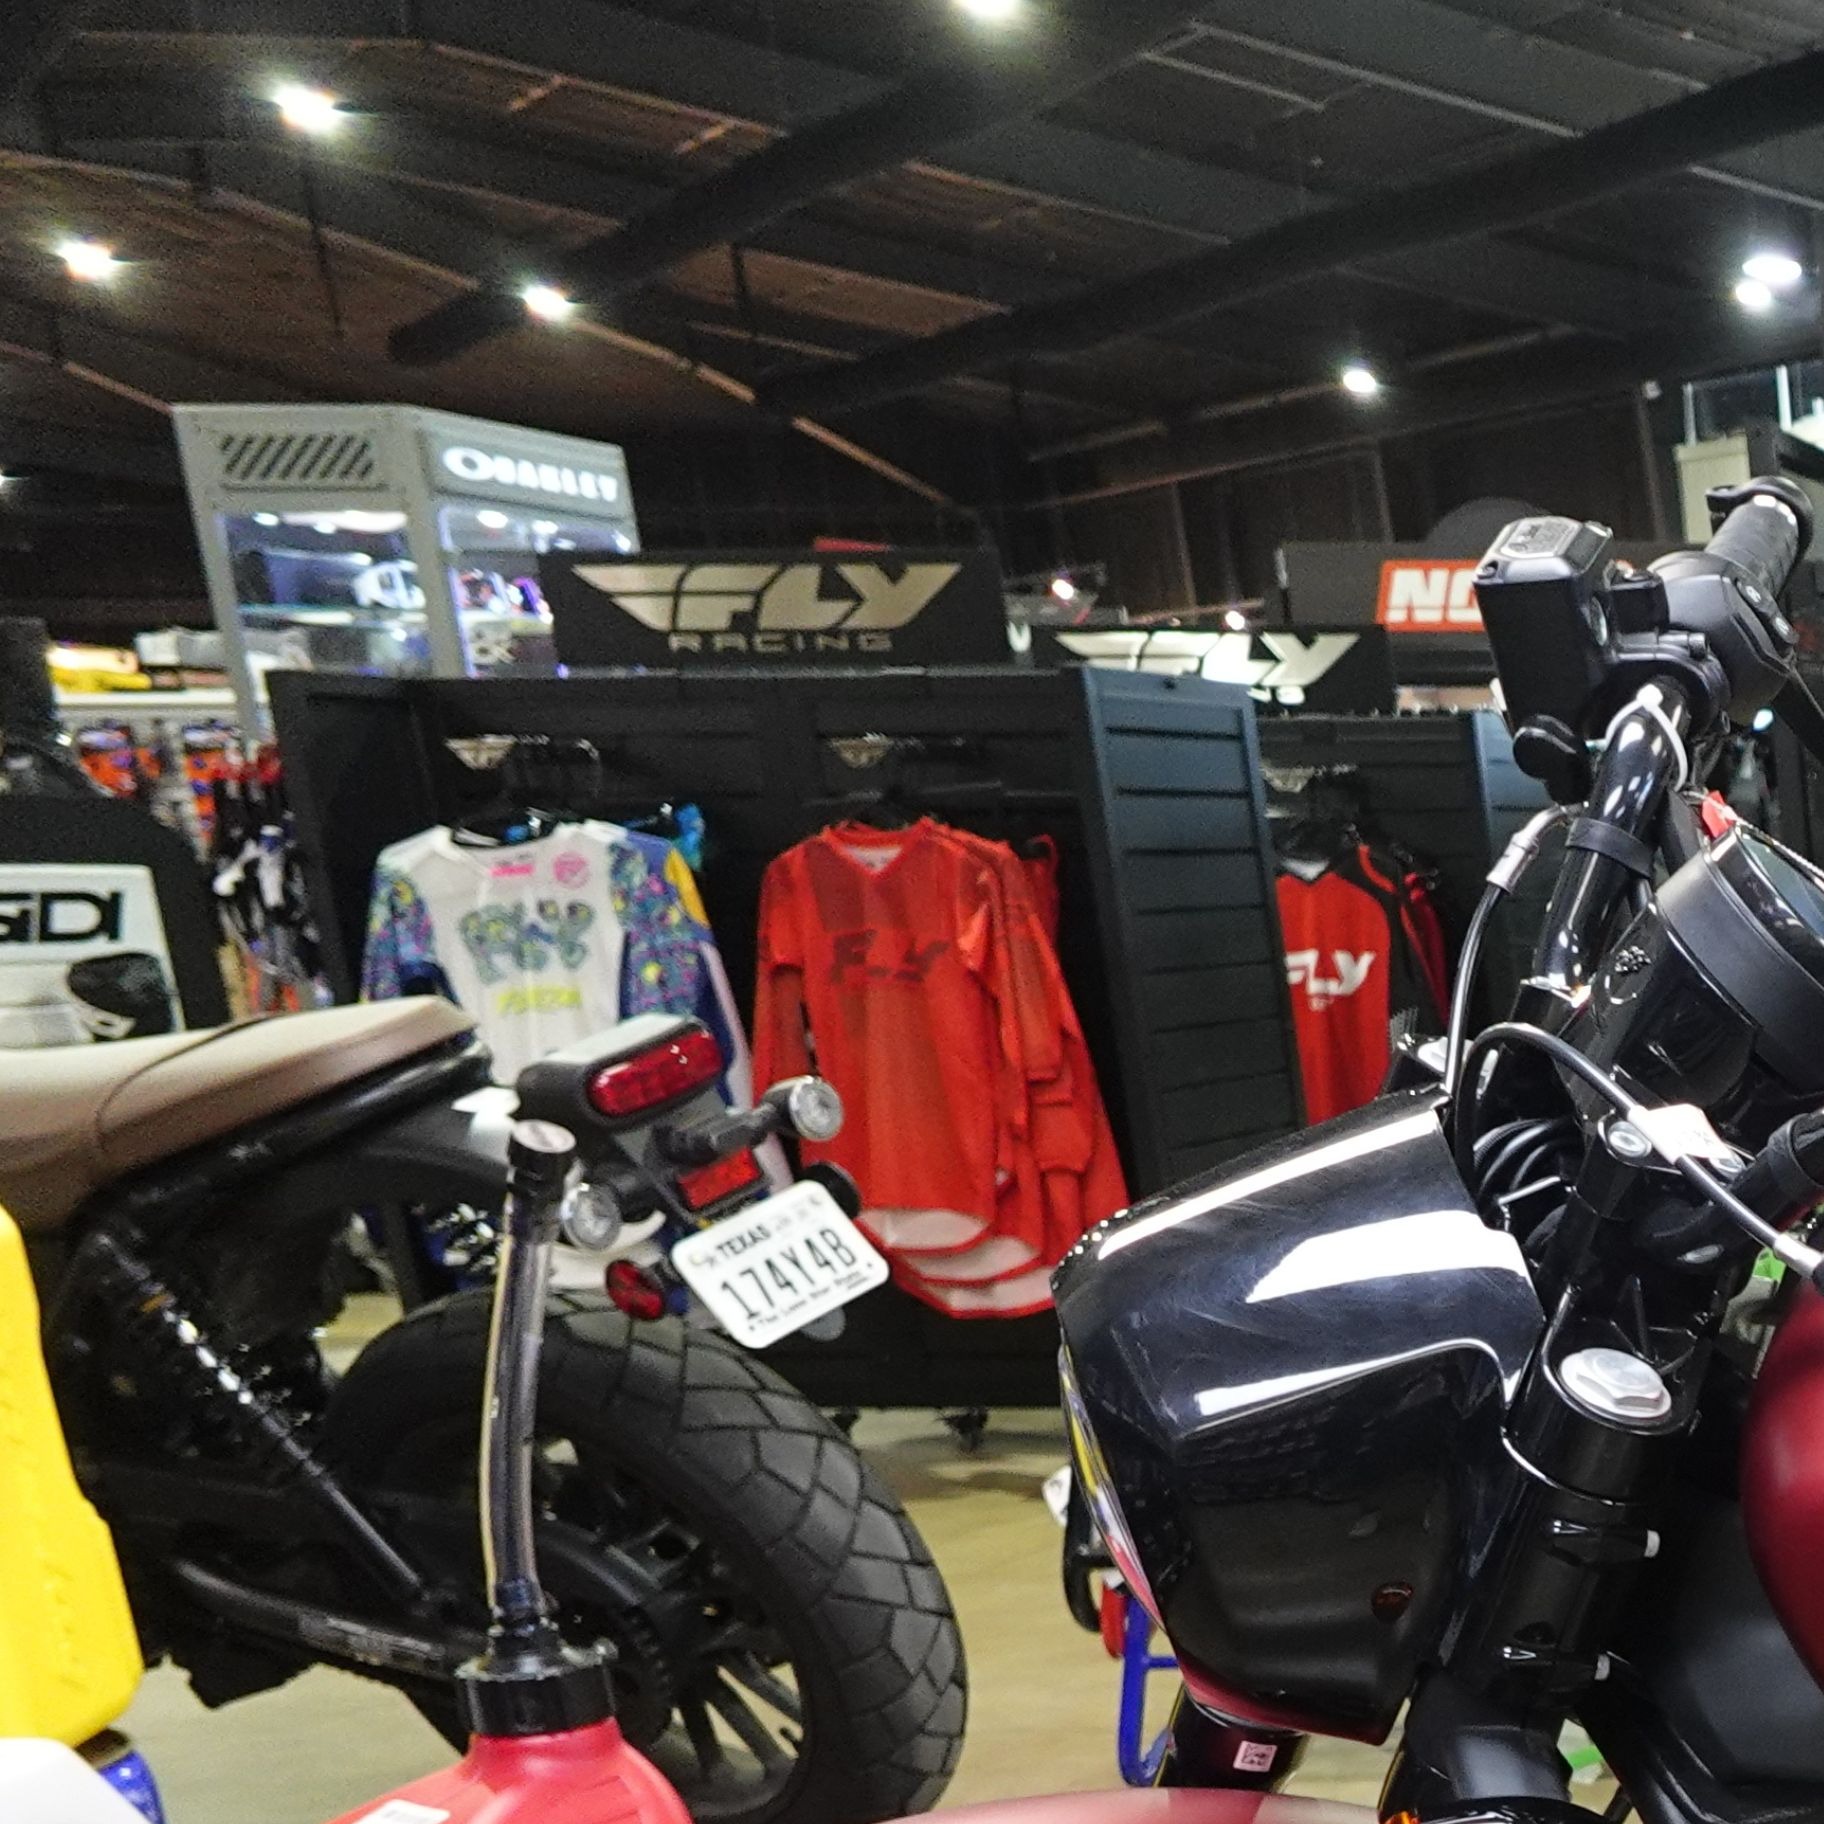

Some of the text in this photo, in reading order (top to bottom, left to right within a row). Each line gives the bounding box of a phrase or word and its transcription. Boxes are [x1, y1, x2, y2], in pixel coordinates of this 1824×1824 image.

[590, 562, 962, 633] FLY
[667, 631, 893, 653] RACING
[716, 1224, 771, 1259] TEXAS
[721, 1228, 857, 1320] 174Y4B
